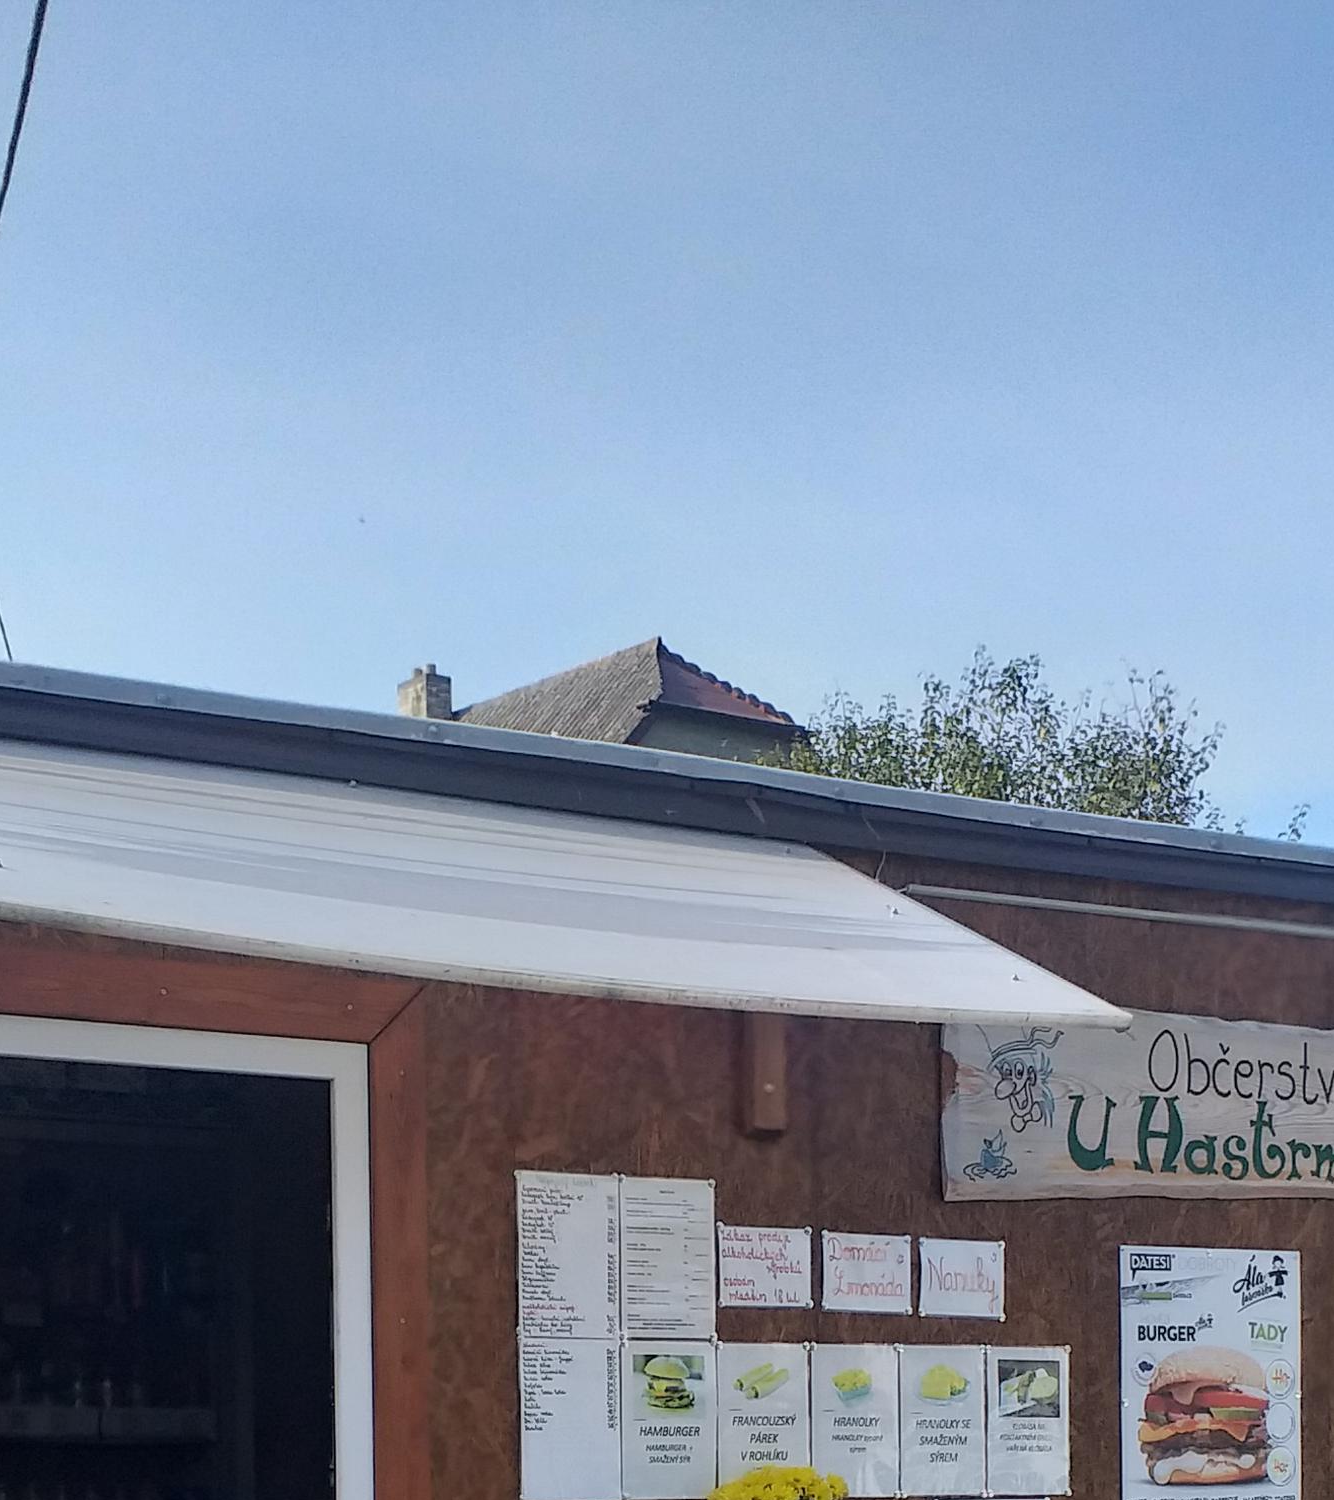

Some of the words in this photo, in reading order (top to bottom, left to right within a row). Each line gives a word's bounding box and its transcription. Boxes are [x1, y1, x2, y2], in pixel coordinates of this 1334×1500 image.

[1067, 1095, 1116, 1172] U
[1131, 1255, 1170, 1270] DATESI
[1137, 1325, 1197, 1342] BURGER
[1248, 1321, 1288, 1343] TADY
[732, 1413, 797, 1427] FRANCOUZSKÝ
[833, 1416, 881, 1428] HRANOLKY
[915, 1418, 960, 1430] HRANOLKY
[961, 1418, 972, 1430] SE
[639, 1425, 701, 1438] HAMBURGER
[749, 1431, 779, 1444] PÁREK
[919, 1433, 968, 1446] SMAŽENÝM
[740, 1451, 748, 1462] V
[749, 1448, 789, 1462] ROHLÍKU
[929, 1451, 959, 1463] SÝREM
